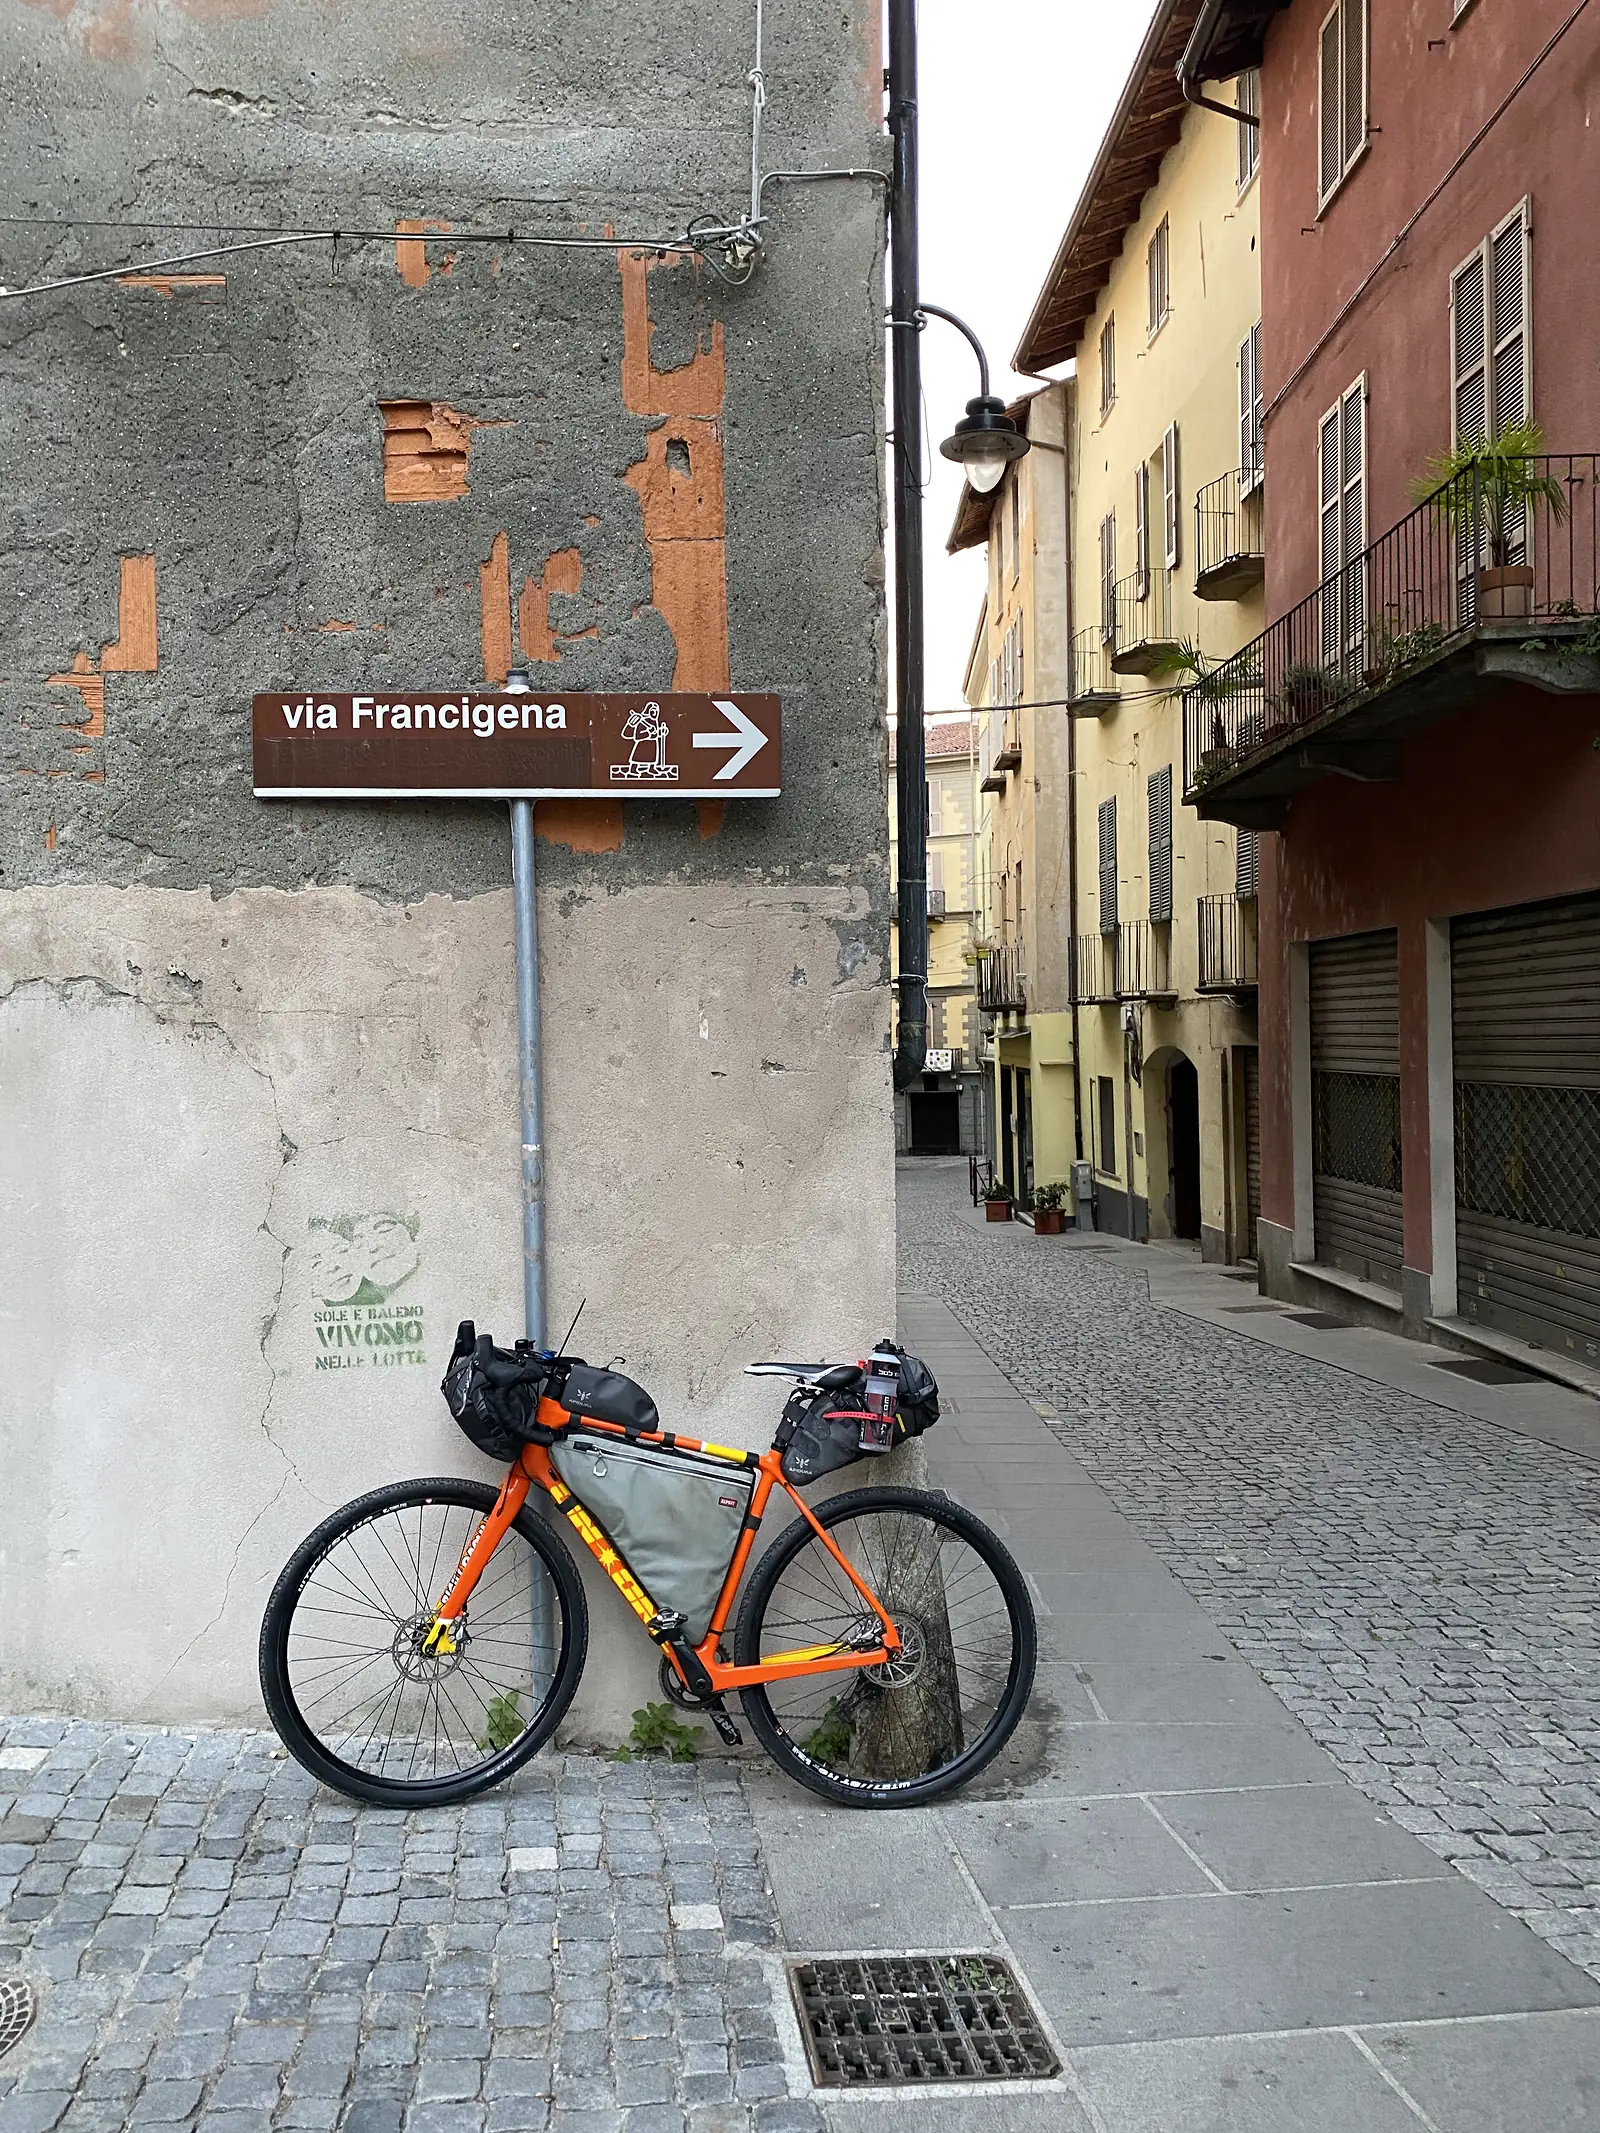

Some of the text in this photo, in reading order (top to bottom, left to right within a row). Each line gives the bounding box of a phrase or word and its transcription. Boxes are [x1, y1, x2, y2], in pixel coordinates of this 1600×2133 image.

[281, 697, 567, 738] via Francigena
[314, 1310, 348, 1322] SOLE
[354, 1309, 362, 1320] E
[316, 1320, 423, 1348] VIVONO
[316, 1355, 364, 1370] NELLE
